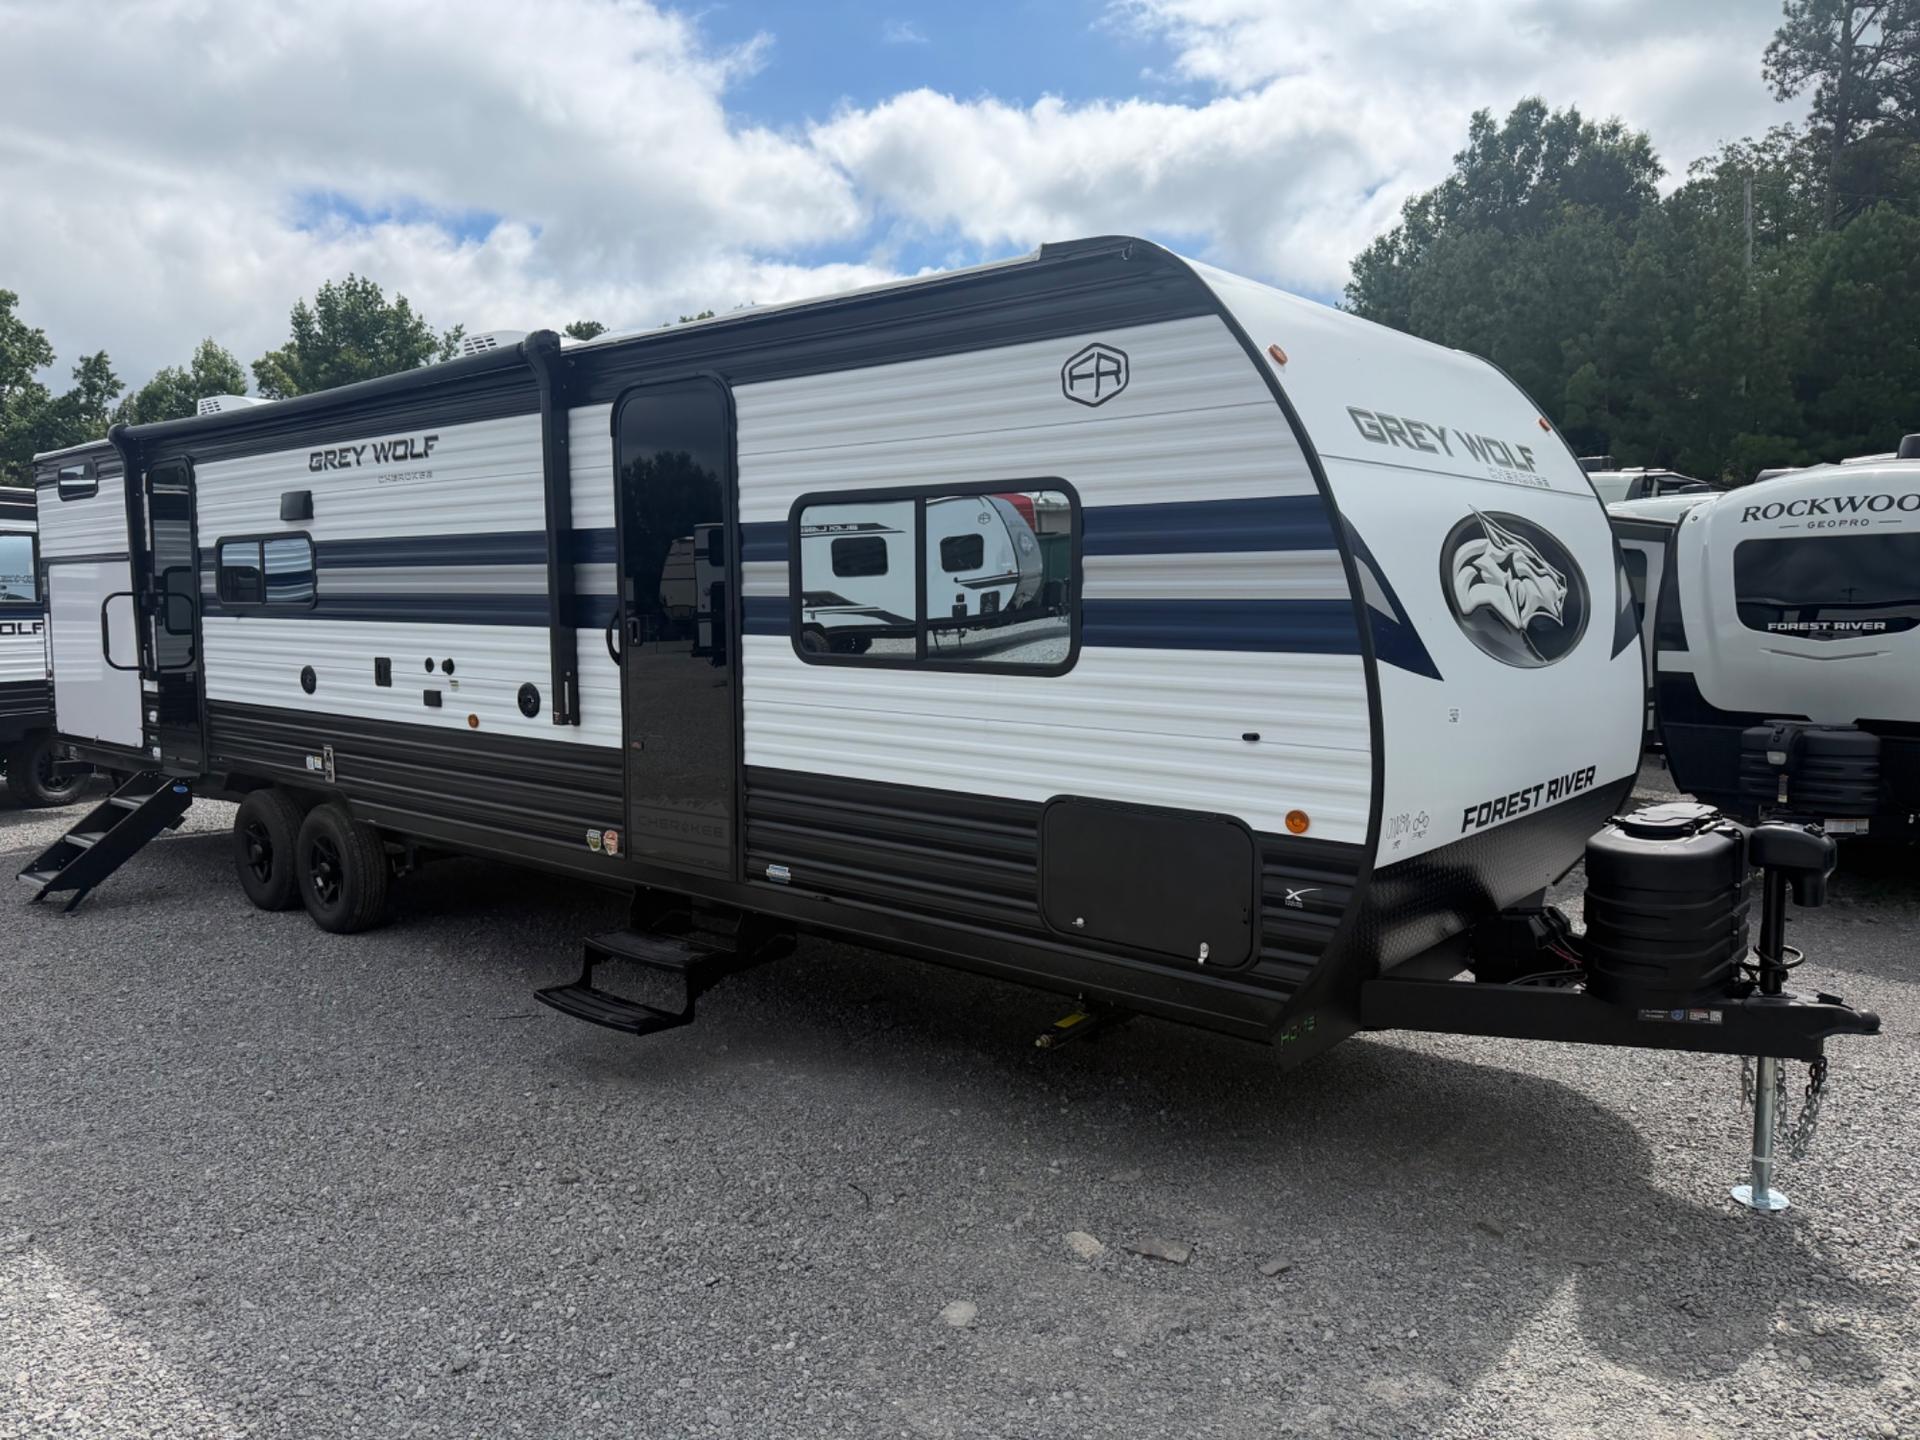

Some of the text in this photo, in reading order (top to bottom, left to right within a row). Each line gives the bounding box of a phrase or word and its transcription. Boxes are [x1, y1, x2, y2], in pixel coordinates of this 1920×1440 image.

[308, 435, 439, 472] GREY WOLF
[1347, 406, 1537, 473] GREY WOLF
[1807, 518, 1870, 529] GEOPRO
[1767, 621, 1886, 631] FOREST RIVER
[1461, 783, 1545, 833] FOREST
[1546, 765, 1597, 803] RIVER
